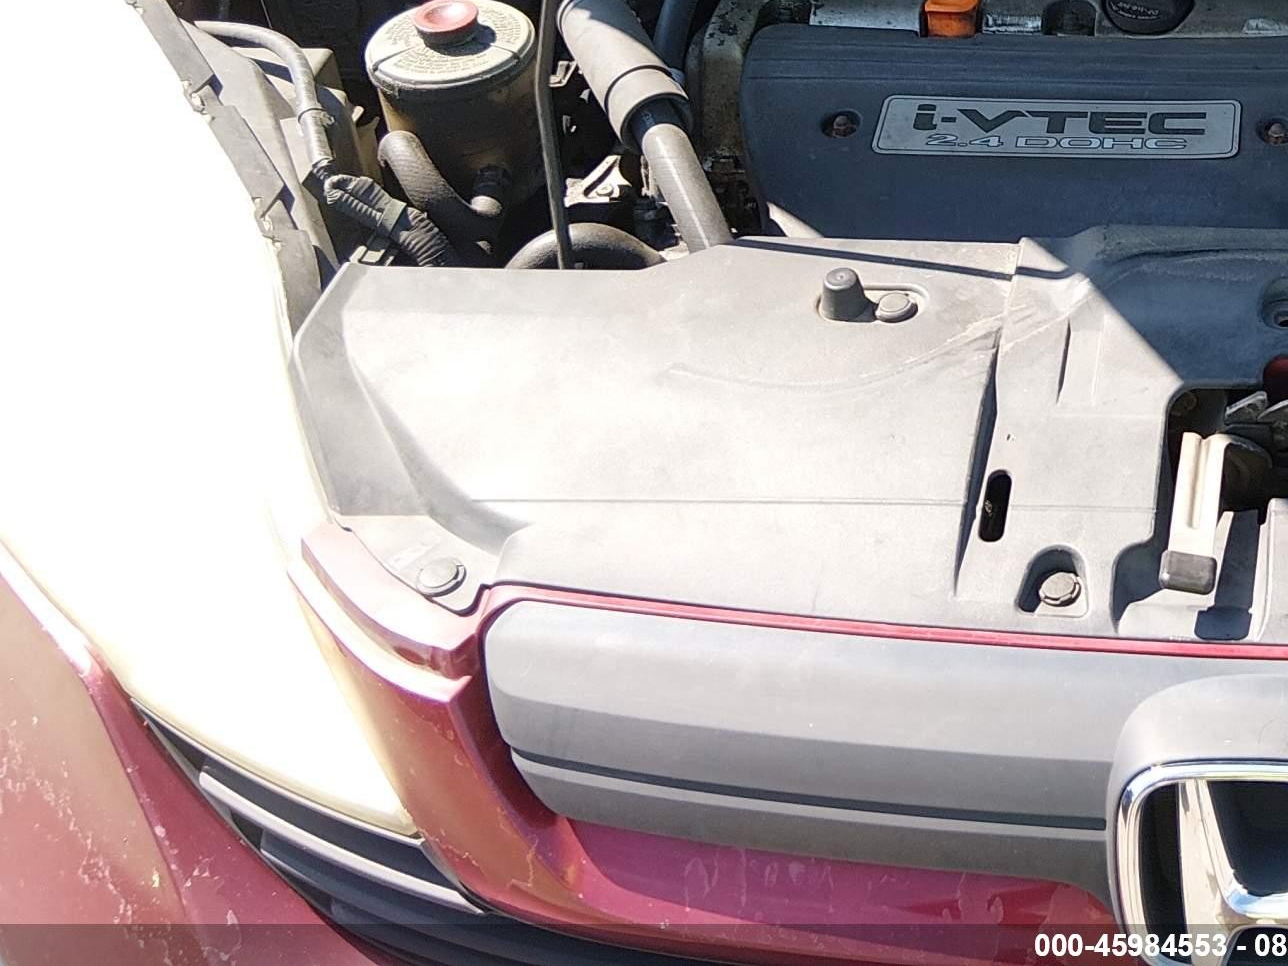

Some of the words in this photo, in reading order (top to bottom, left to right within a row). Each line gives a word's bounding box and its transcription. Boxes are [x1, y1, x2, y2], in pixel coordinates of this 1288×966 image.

[913, 104, 1207, 135] i-VTEC
[926, 134, 1004, 148] 2.4
[1015, 136, 1188, 150] DOHC
